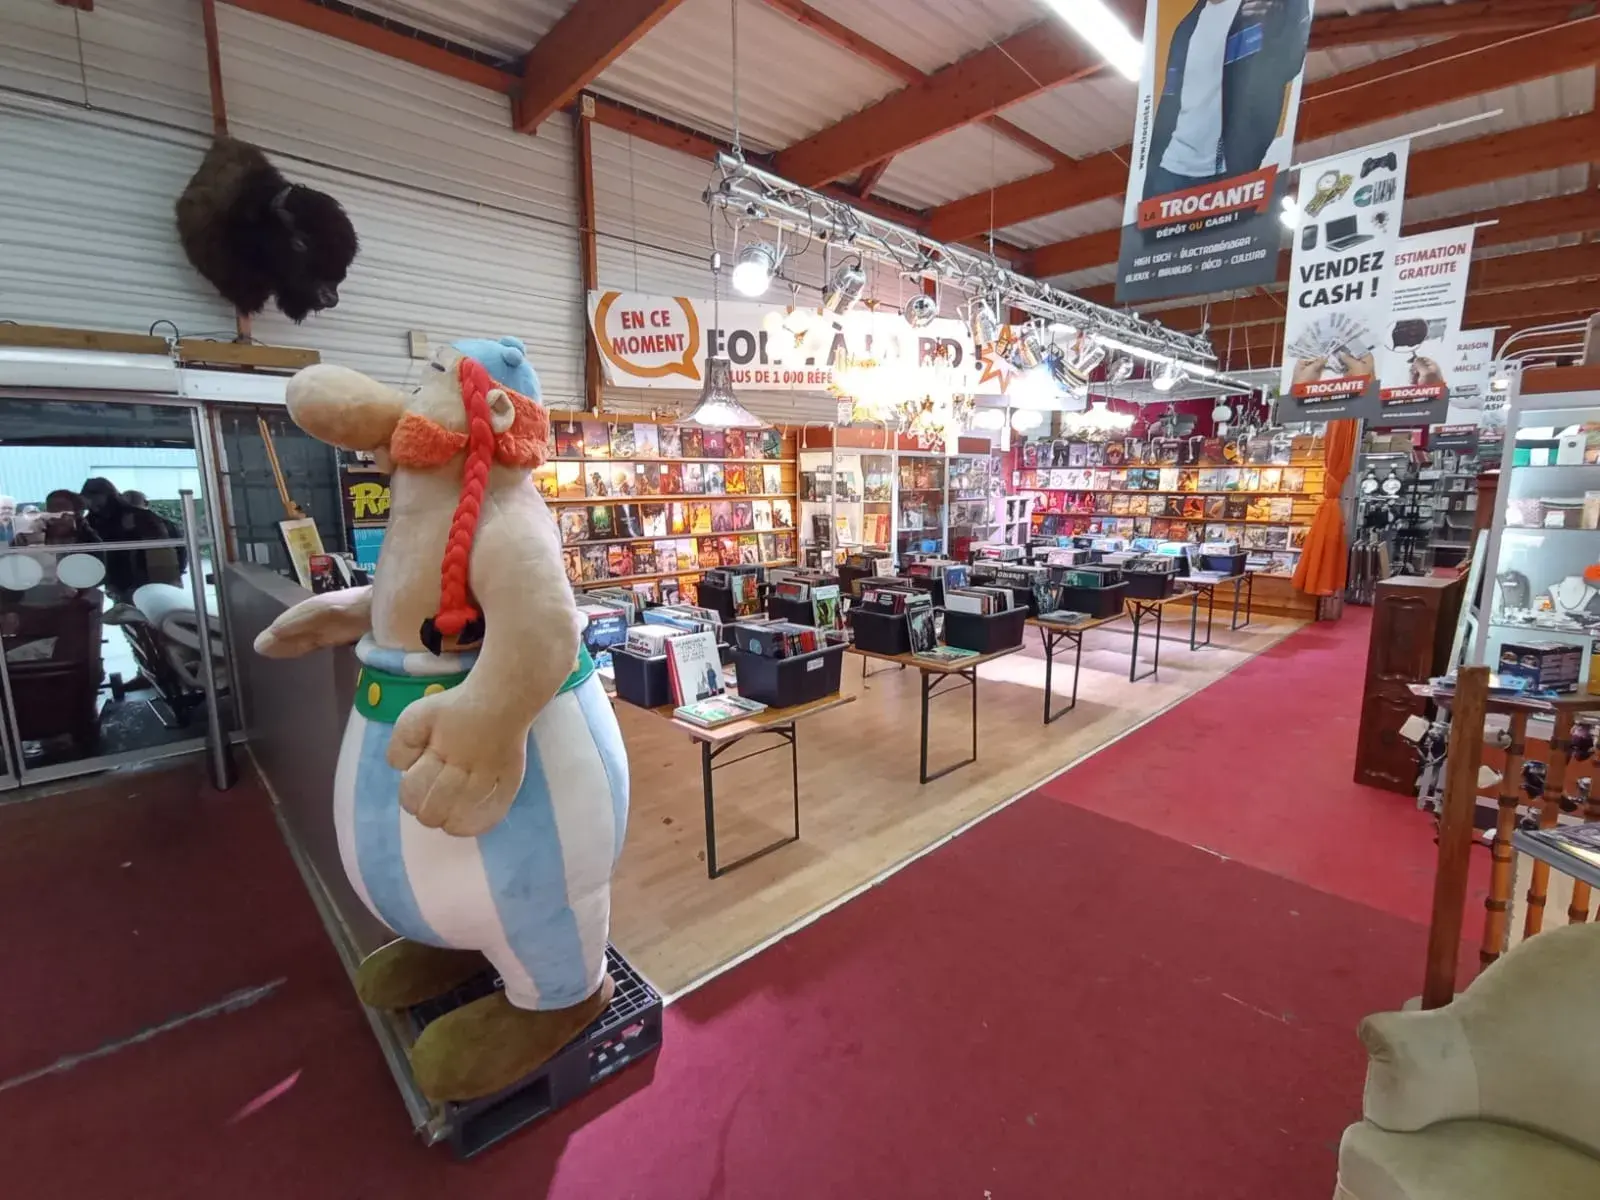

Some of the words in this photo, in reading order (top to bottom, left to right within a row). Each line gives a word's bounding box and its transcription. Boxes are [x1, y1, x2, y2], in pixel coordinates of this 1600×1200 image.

[1160, 180, 1266, 219] TROCANTE
[1156, 226, 1187, 239] DÉPÔT
[1188, 222, 1203, 232] OU
[1205, 213, 1232, 228] CASH
[1394, 243, 1467, 266] ESTIMATION
[1300, 251, 1385, 284] VENDEZ
[1398, 261, 1457, 281] GRATUITE
[1298, 281, 1363, 309] CASH
[621, 311, 645, 329] EN
[650, 310, 671, 328] CE
[613, 334, 684, 355] MOMENT
[1456, 342, 1489, 351] RAISON
[729, 369, 752, 384] LUS
[755, 370, 770, 384] DE
[773, 371, 781, 384] 1
[783, 371, 804, 384] 000
[1305, 380, 1364, 394] TROCANTE
[1391, 386, 1441, 399] TROCANTE
